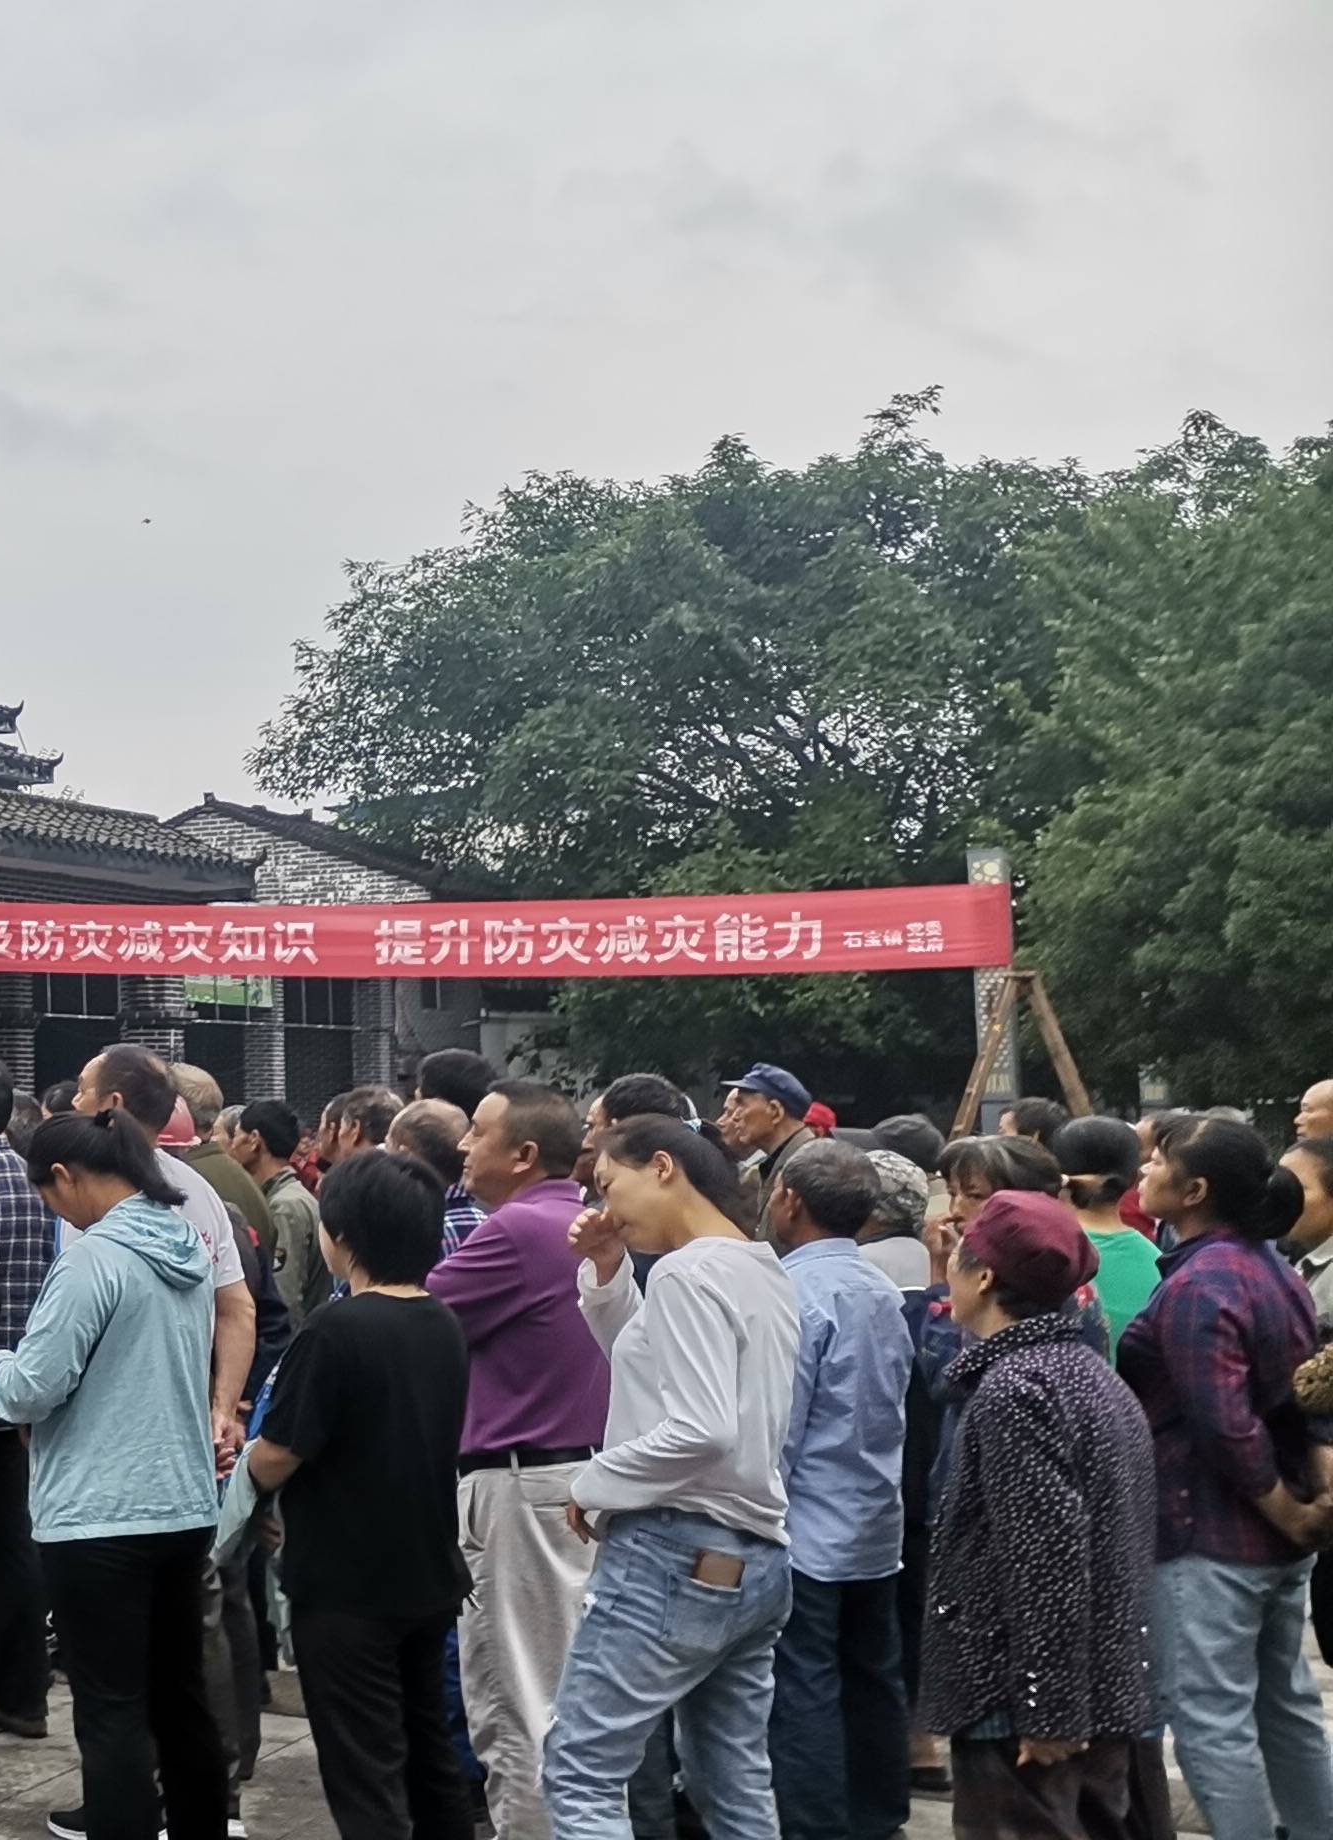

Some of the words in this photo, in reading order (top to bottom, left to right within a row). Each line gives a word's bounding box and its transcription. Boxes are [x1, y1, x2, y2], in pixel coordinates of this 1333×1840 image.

[374, 911, 823, 966] 提升防灾减灾能力
[843, 930, 903, 948] 石宝镇
